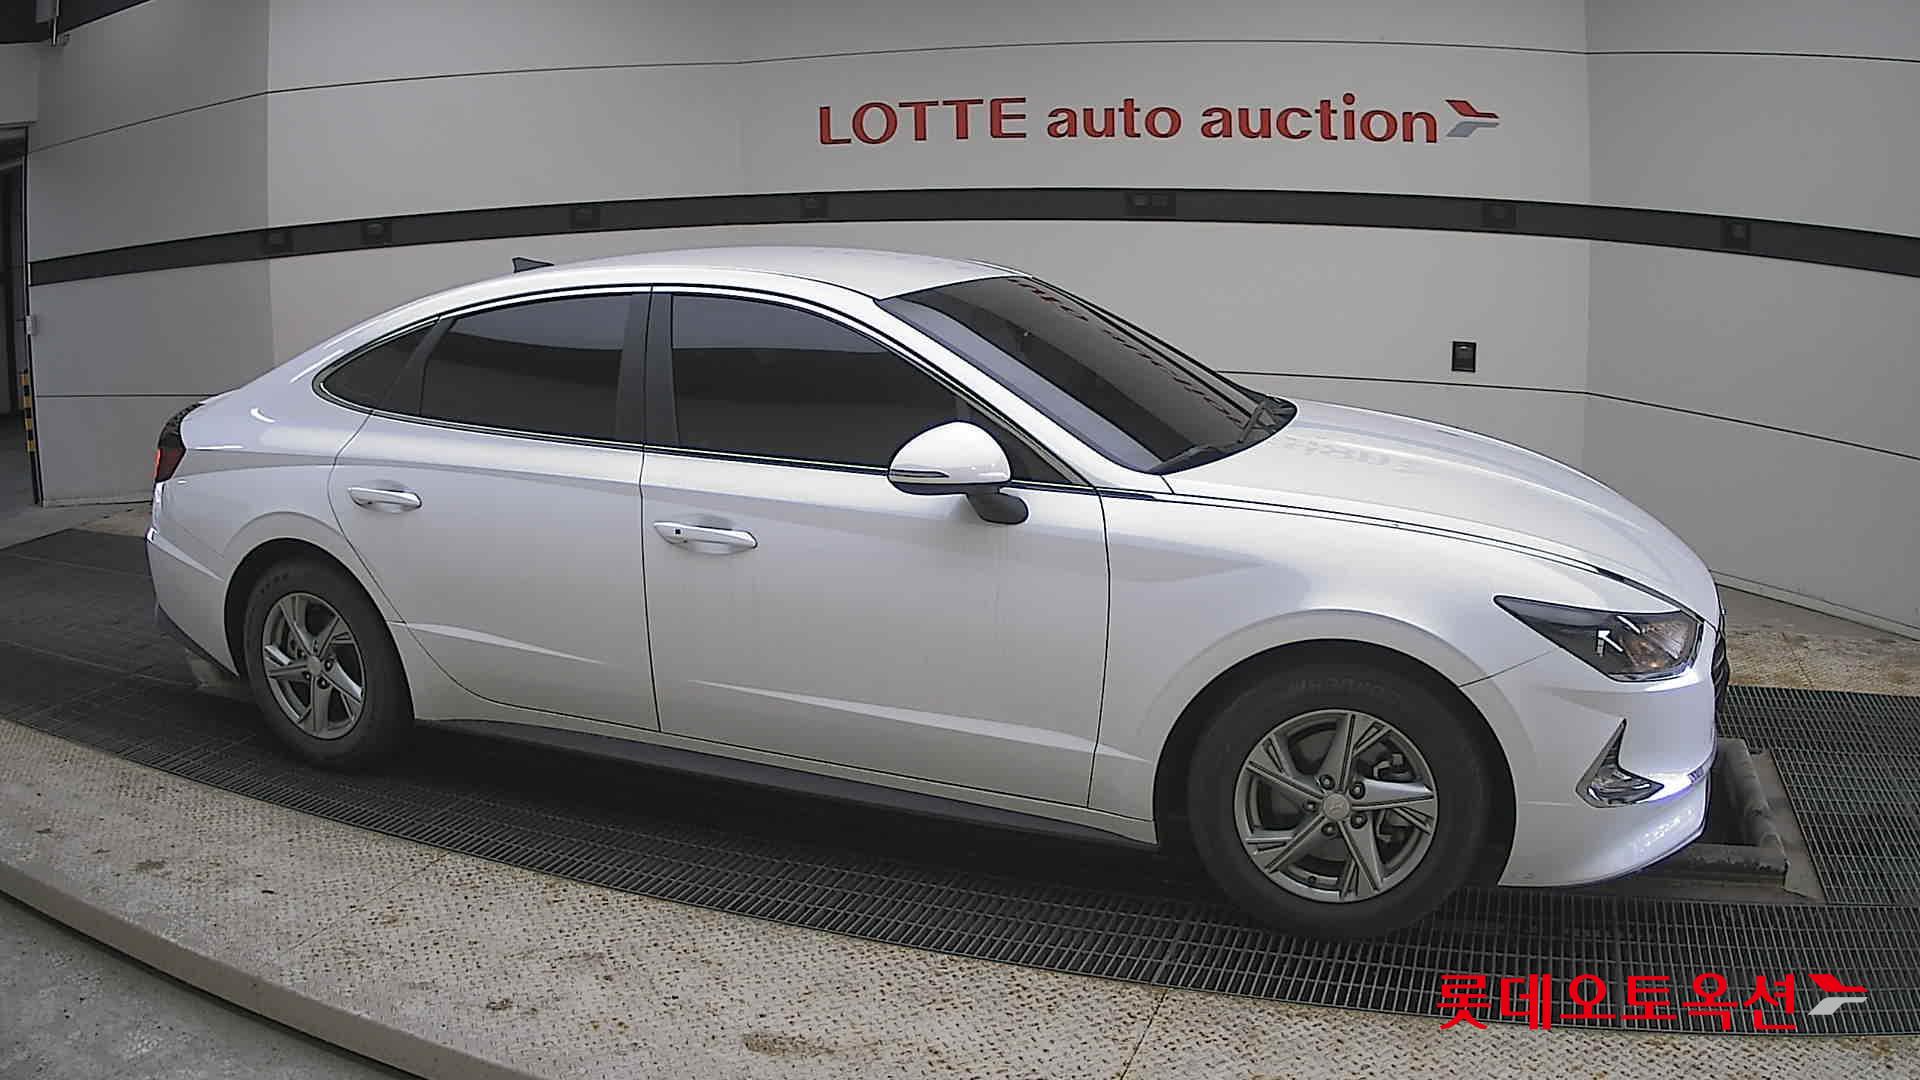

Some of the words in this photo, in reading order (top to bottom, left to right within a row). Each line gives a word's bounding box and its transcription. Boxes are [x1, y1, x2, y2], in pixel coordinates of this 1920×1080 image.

[820, 97, 1027, 146] LOTTE
[1047, 97, 1182, 138] auto
[1201, 92, 1438, 144] auction
